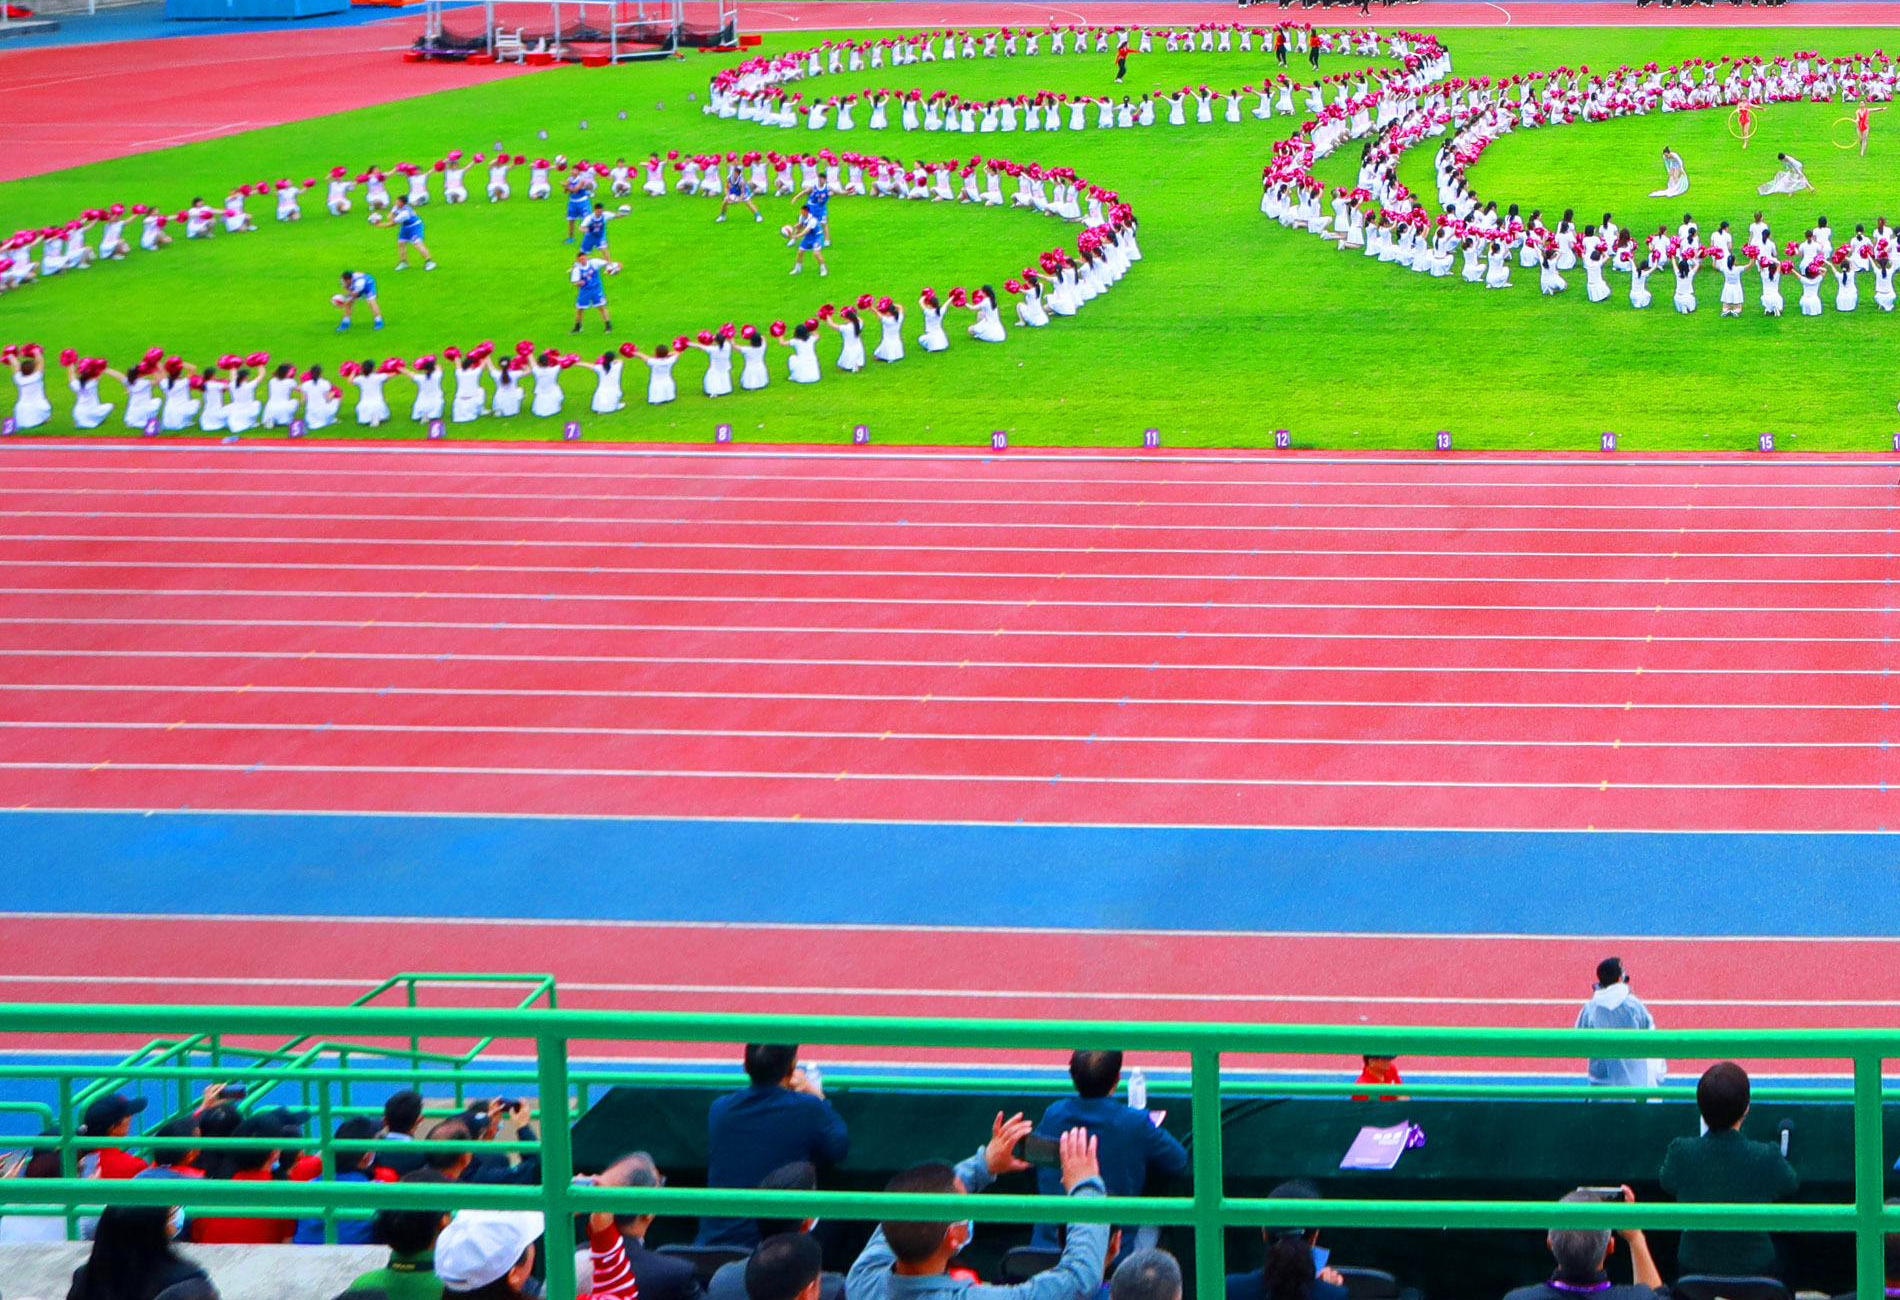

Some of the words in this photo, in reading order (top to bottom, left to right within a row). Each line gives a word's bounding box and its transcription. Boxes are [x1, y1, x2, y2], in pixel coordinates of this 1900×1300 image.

[431, 422, 441, 438] 6
[567, 423, 577, 439] 7
[718, 427, 728, 441] 8
[856, 427, 865, 441] 9
[992, 434, 1005, 448] 10
[1145, 431, 1157, 446] 11
[1276, 432, 1288, 446] 12
[1437, 434, 1449, 448] 13
[1601, 435, 1613, 449] 14
[1760, 436, 1772, 449] 15
